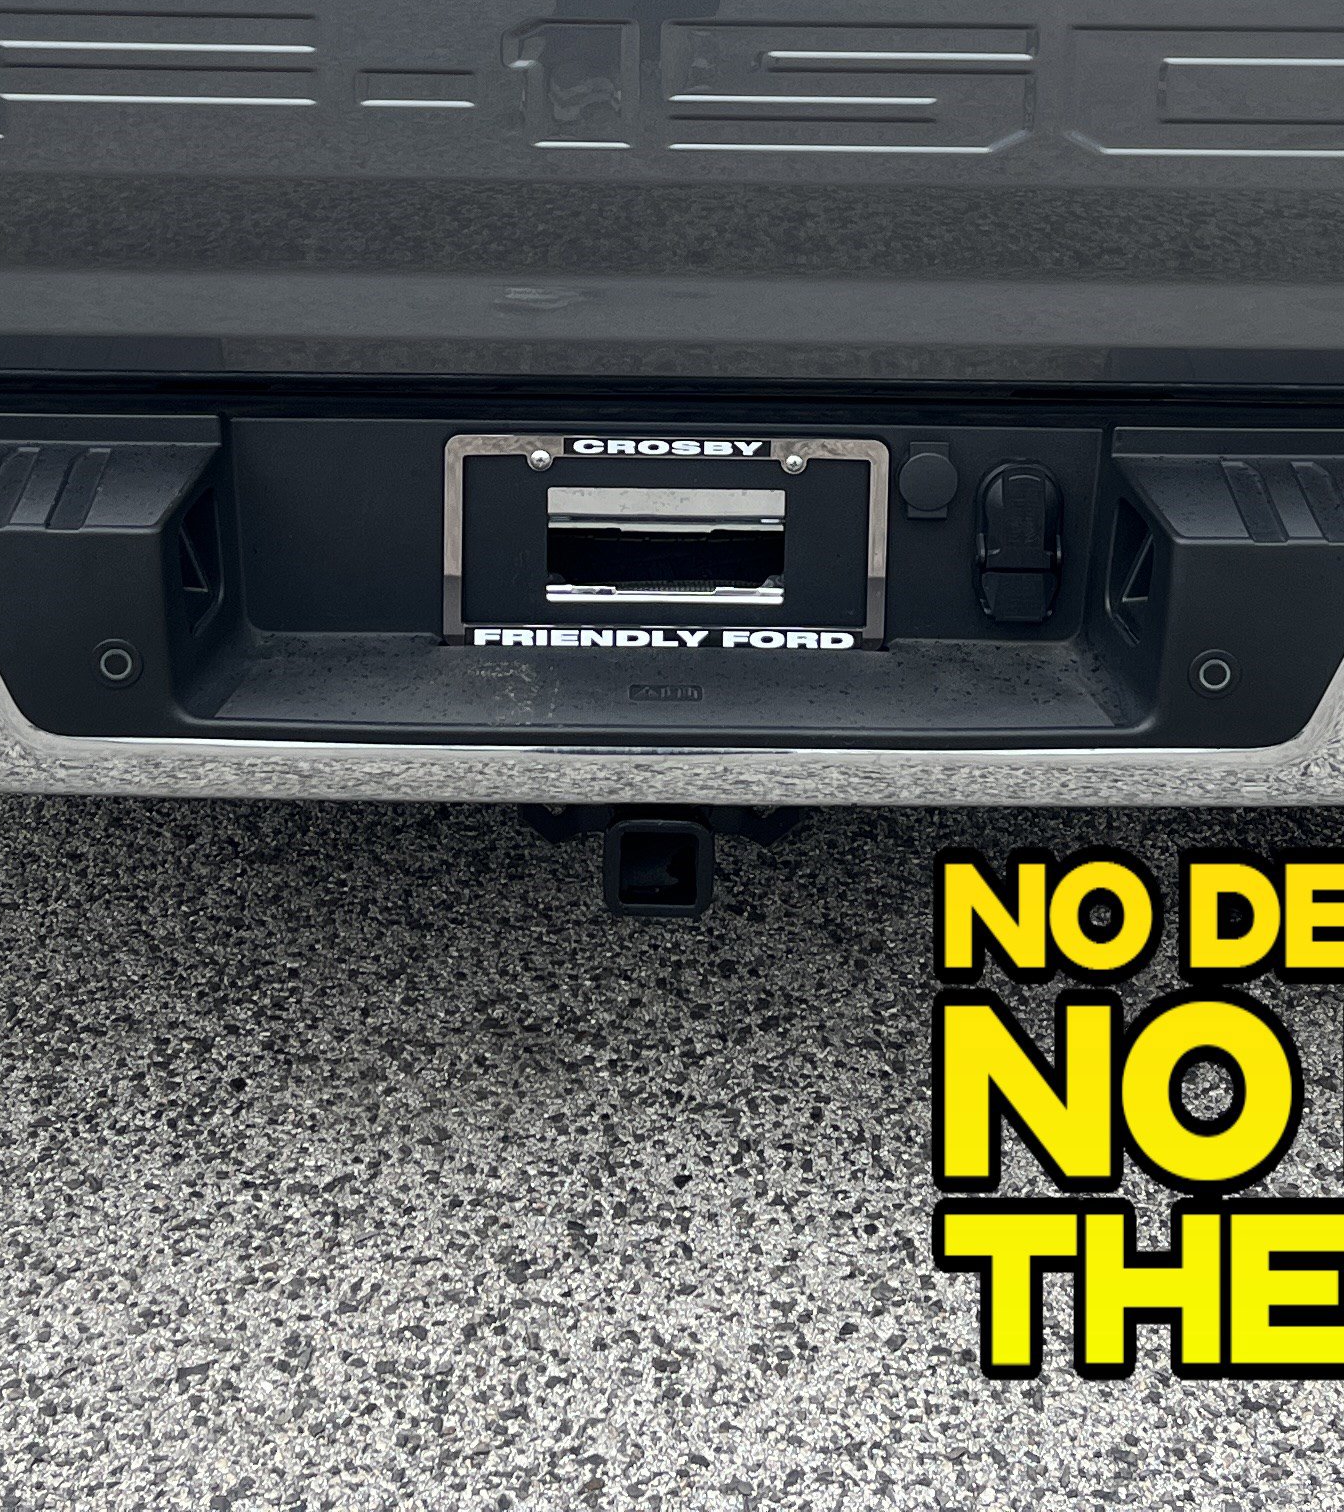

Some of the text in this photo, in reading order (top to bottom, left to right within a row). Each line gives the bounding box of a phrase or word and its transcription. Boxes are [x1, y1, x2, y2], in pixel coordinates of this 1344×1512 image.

[573, 439, 763, 456] CROSBY
[473, 629, 855, 650] FRIENDLY FORD
